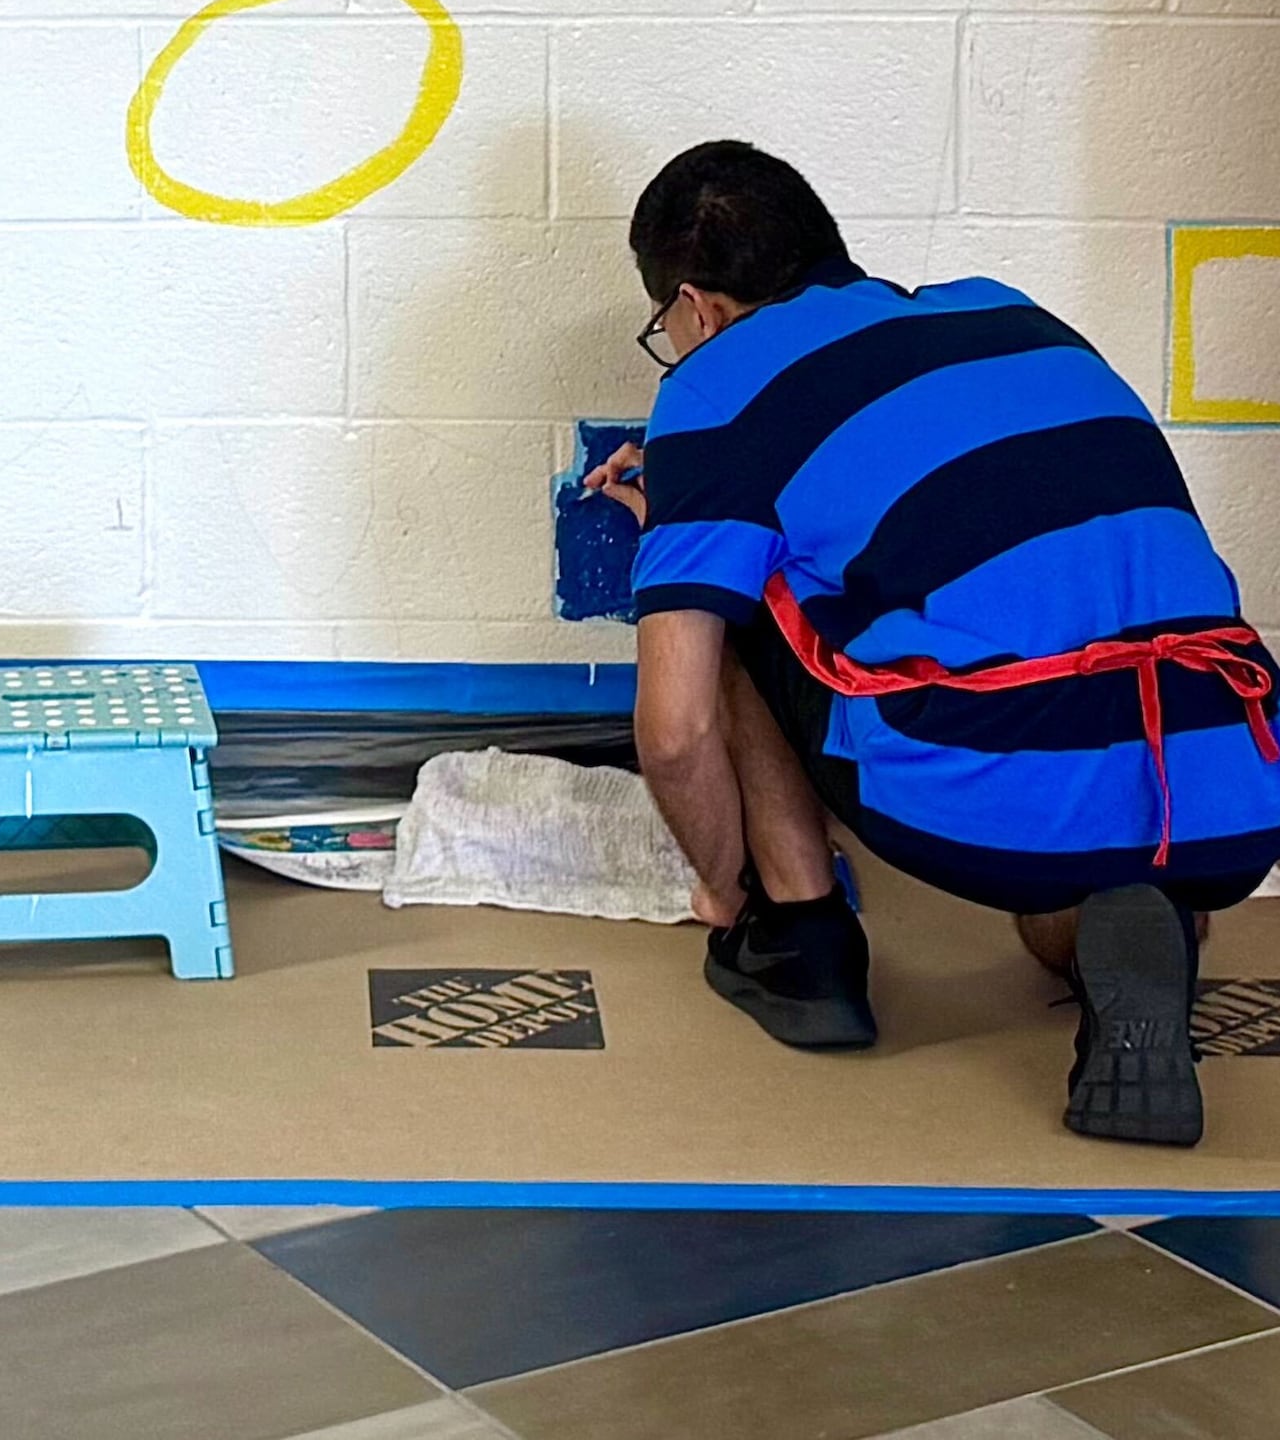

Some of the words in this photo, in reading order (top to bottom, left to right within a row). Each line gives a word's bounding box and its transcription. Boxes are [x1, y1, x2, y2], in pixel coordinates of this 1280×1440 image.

[372, 970, 592, 1046] HOME
[391, 976, 483, 1009] THE
[463, 1000, 597, 1047] DEPOT
